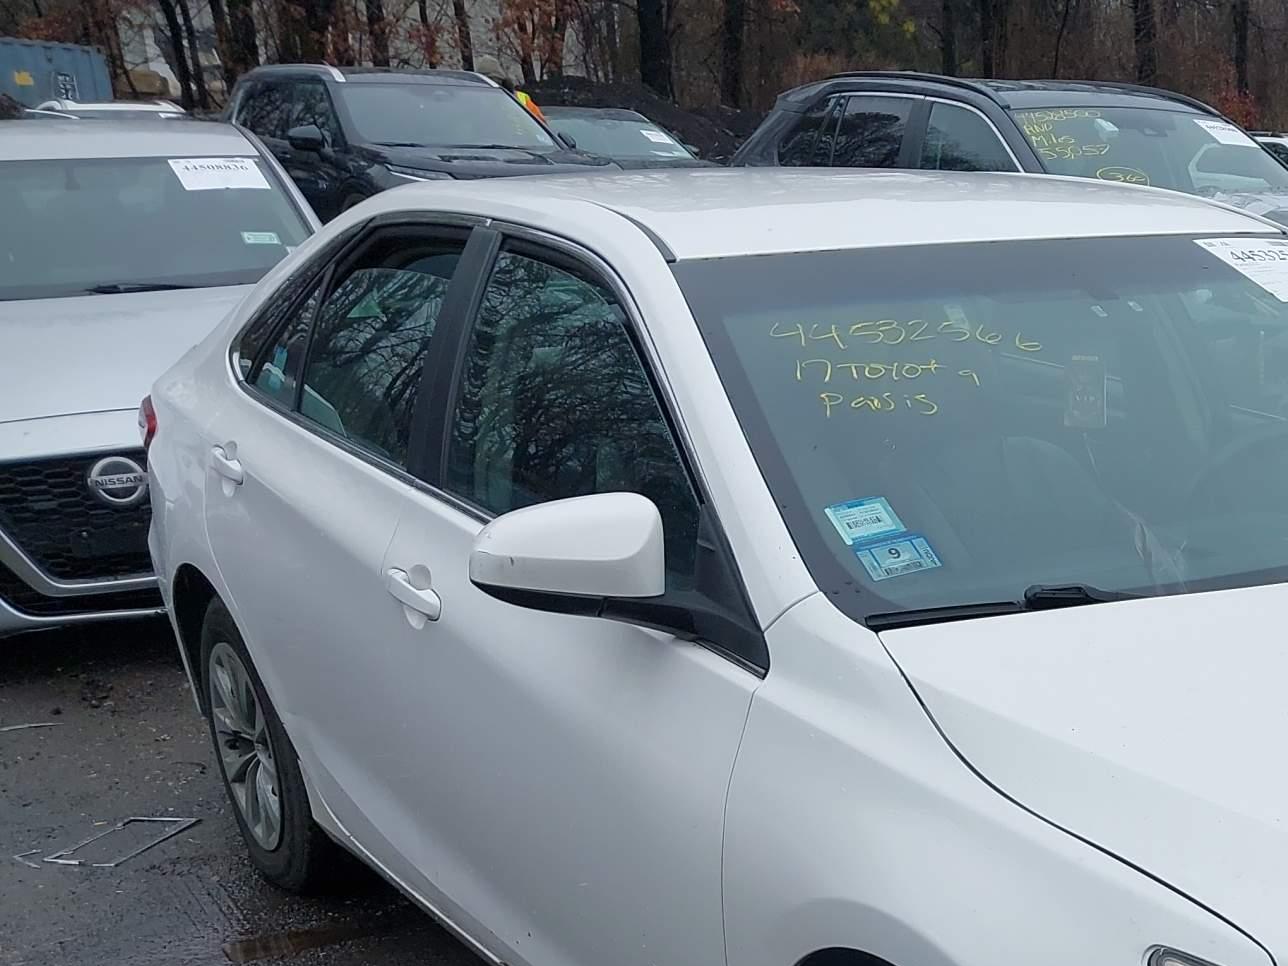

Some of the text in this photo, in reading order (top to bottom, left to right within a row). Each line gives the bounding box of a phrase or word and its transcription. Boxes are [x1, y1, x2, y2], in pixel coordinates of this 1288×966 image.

[769, 319, 1042, 352] 44532566
[95, 475, 143, 487] NISSAN
[887, 547, 902, 560] 9
